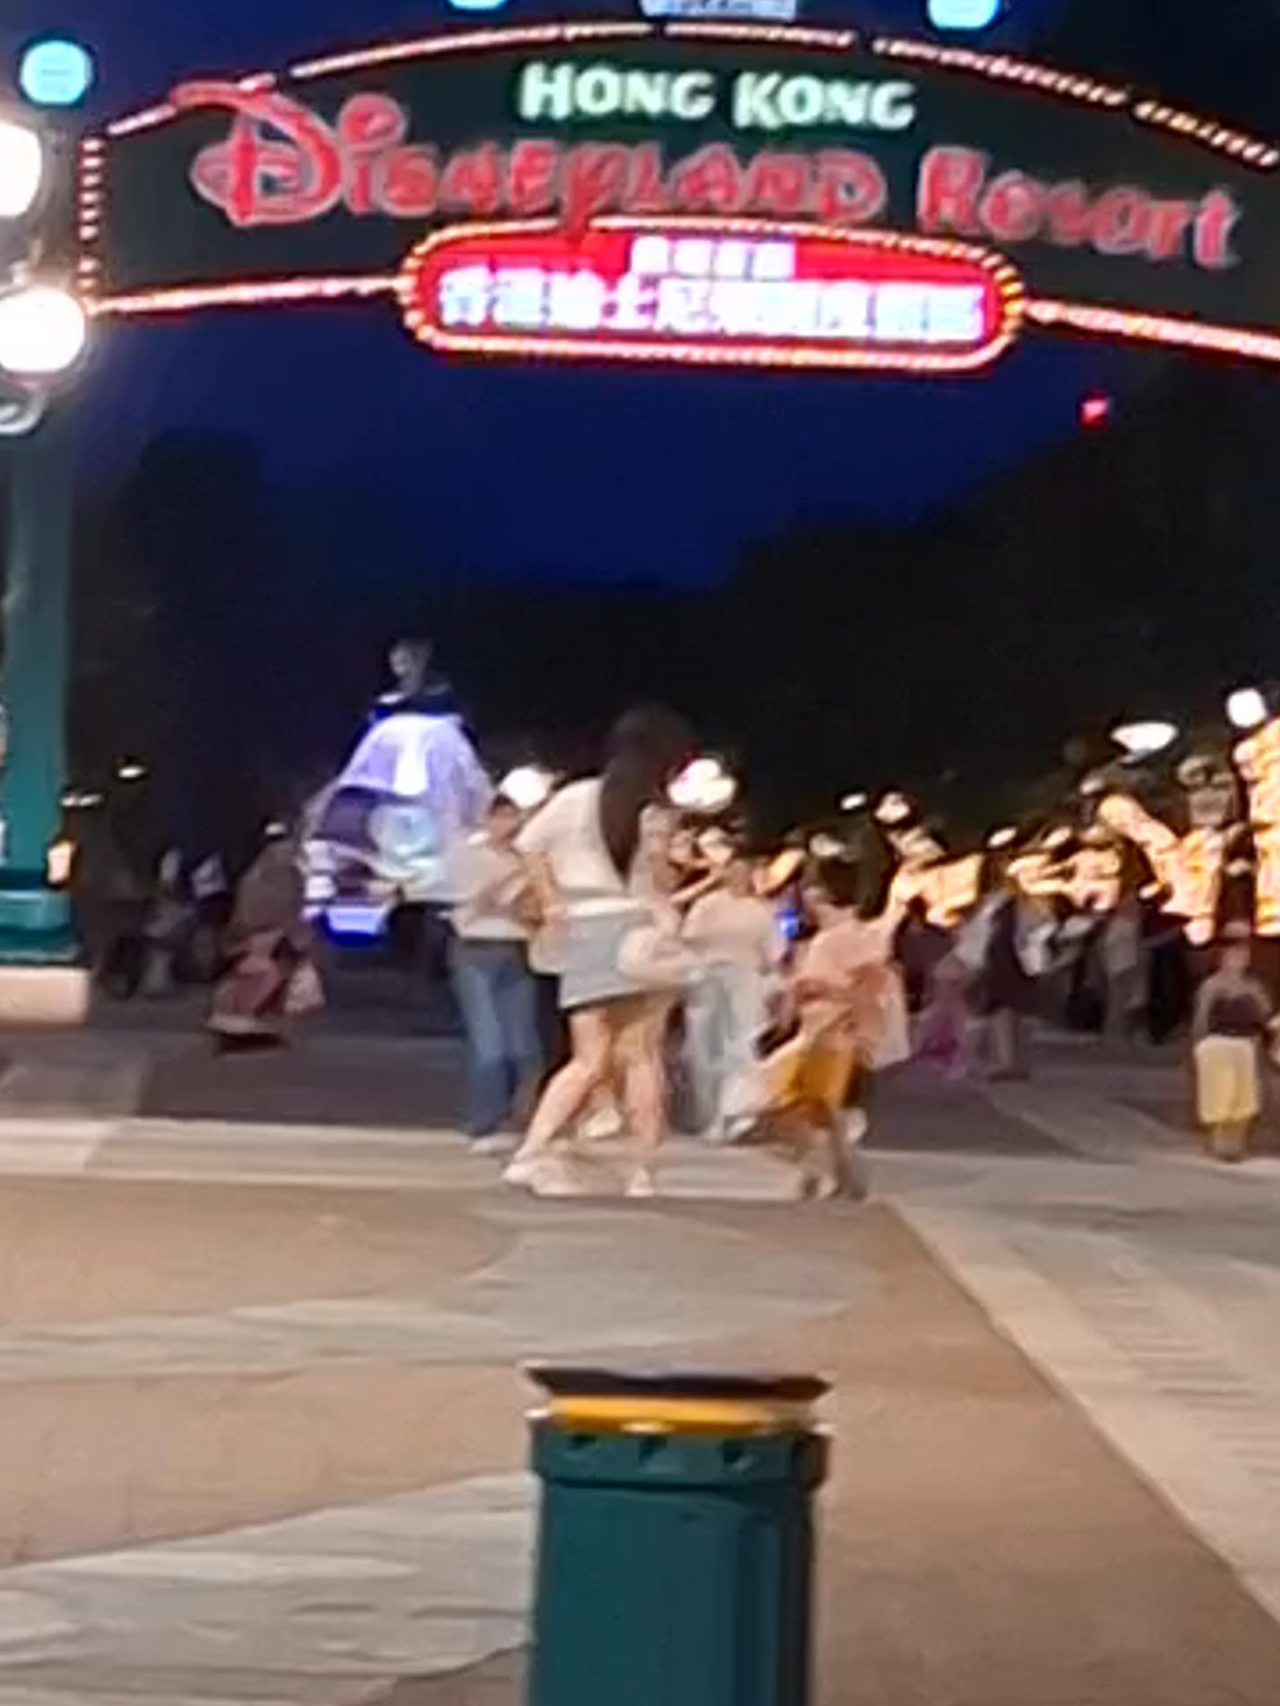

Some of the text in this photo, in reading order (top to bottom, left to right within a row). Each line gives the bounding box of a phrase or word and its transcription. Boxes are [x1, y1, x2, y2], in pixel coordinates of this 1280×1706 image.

[519, 62, 916, 130] HONG KONG
[916, 146, 1245, 270] Resort
